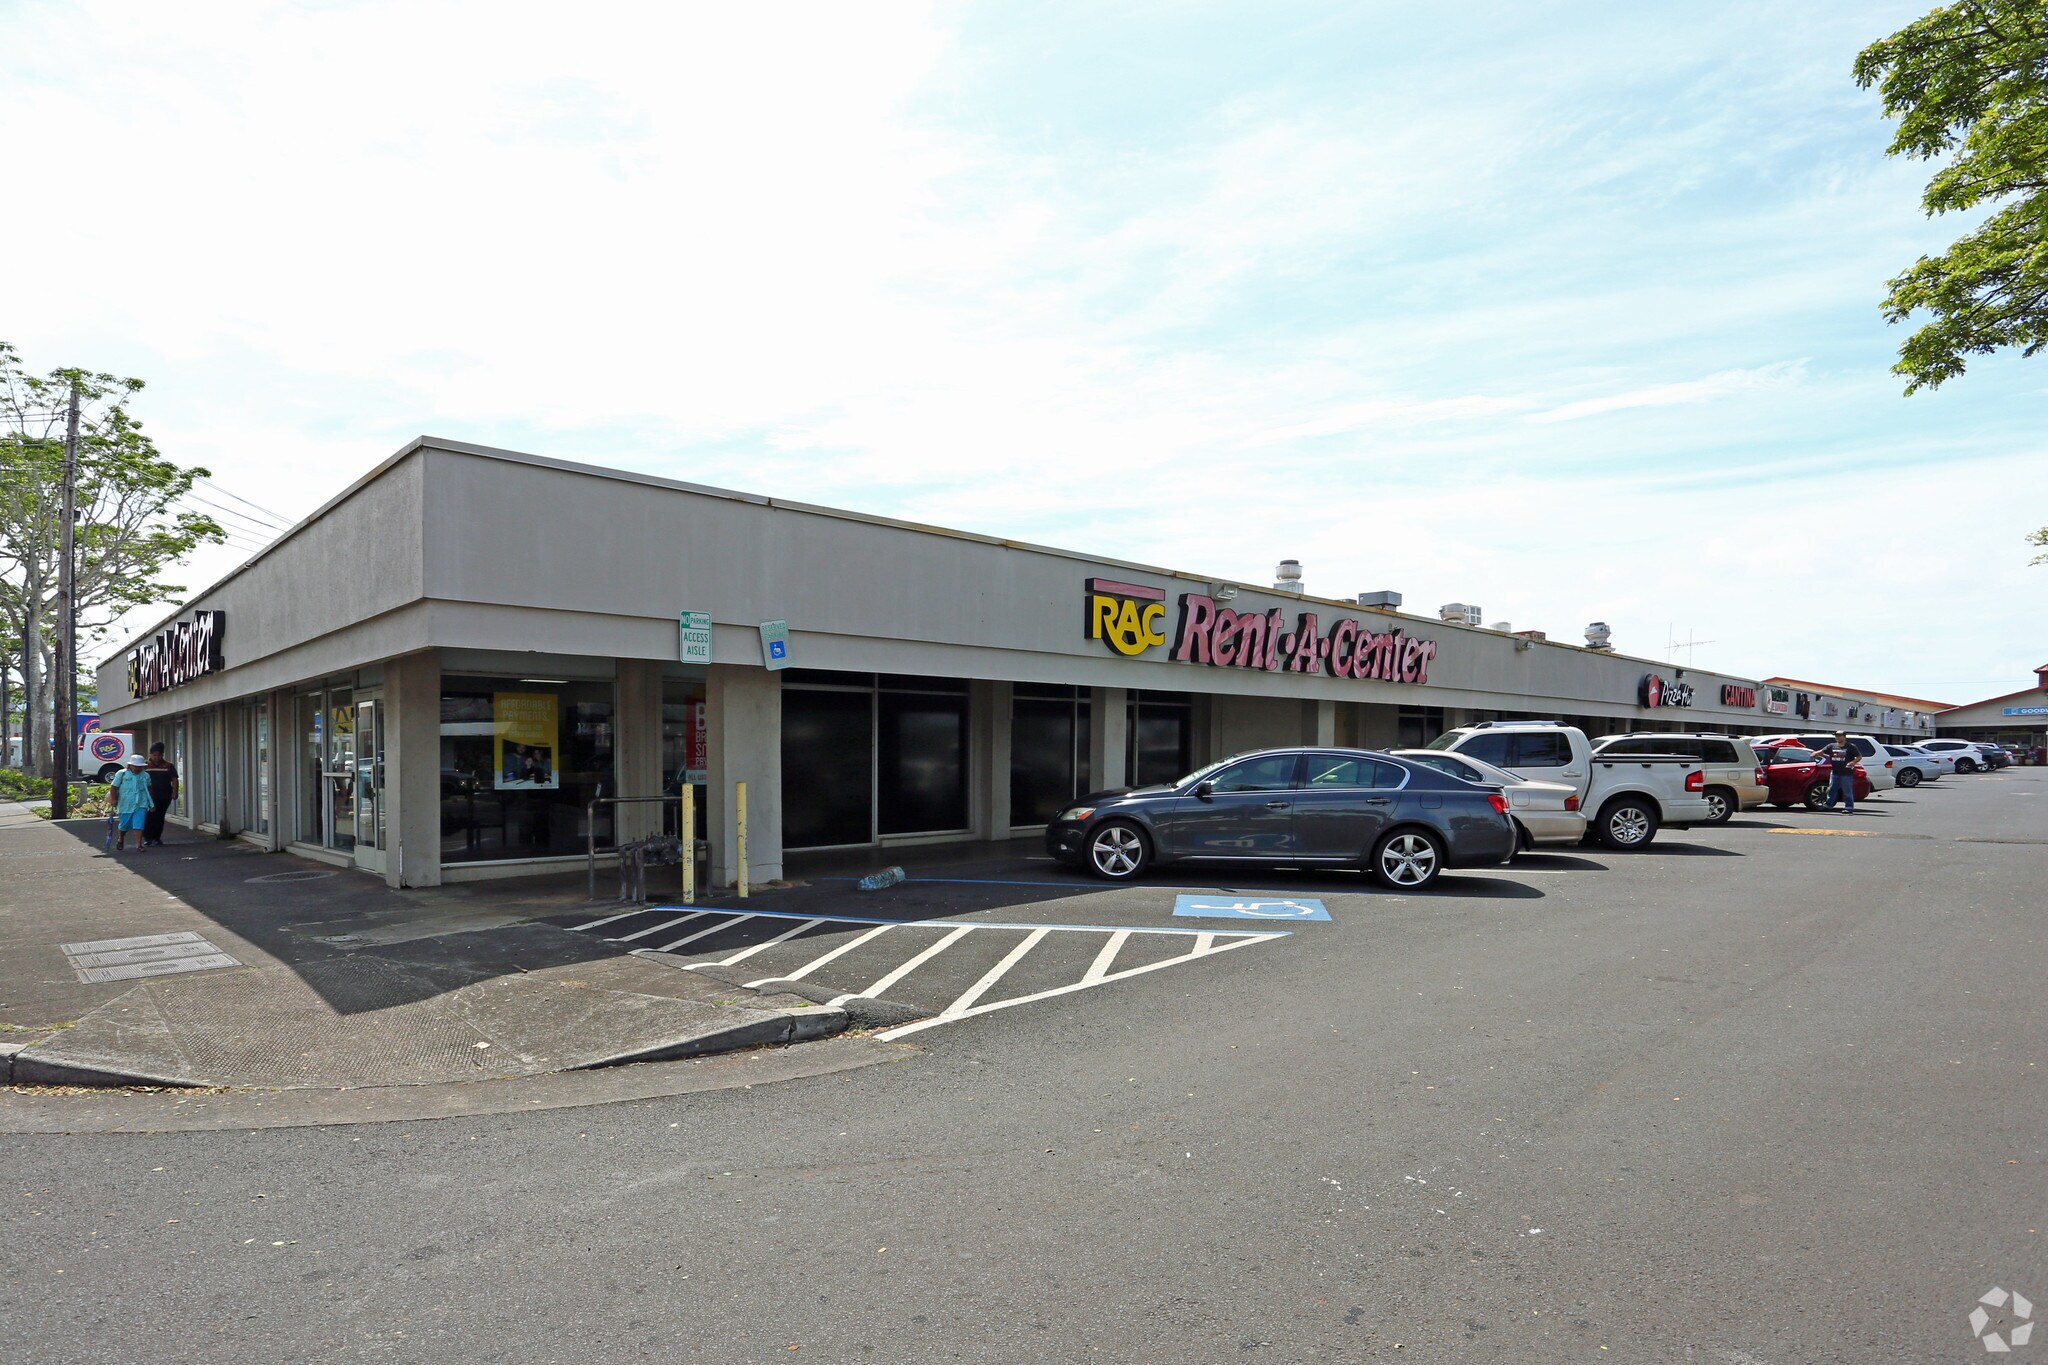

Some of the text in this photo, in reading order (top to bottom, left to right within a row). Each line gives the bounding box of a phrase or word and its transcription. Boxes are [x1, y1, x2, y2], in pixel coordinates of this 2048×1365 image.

[681, 614, 710, 626] NO PARKING
[1092, 594, 1166, 656] RAC
[683, 631, 709, 643] ACCESS
[686, 645, 706, 656] AISLE
[1661, 680, 1681, 706] Pizza
[1724, 684, 1756, 708] CANTINA
[500, 698, 552, 711] AFFORDABLE
[99, 743, 117, 753] RAC
